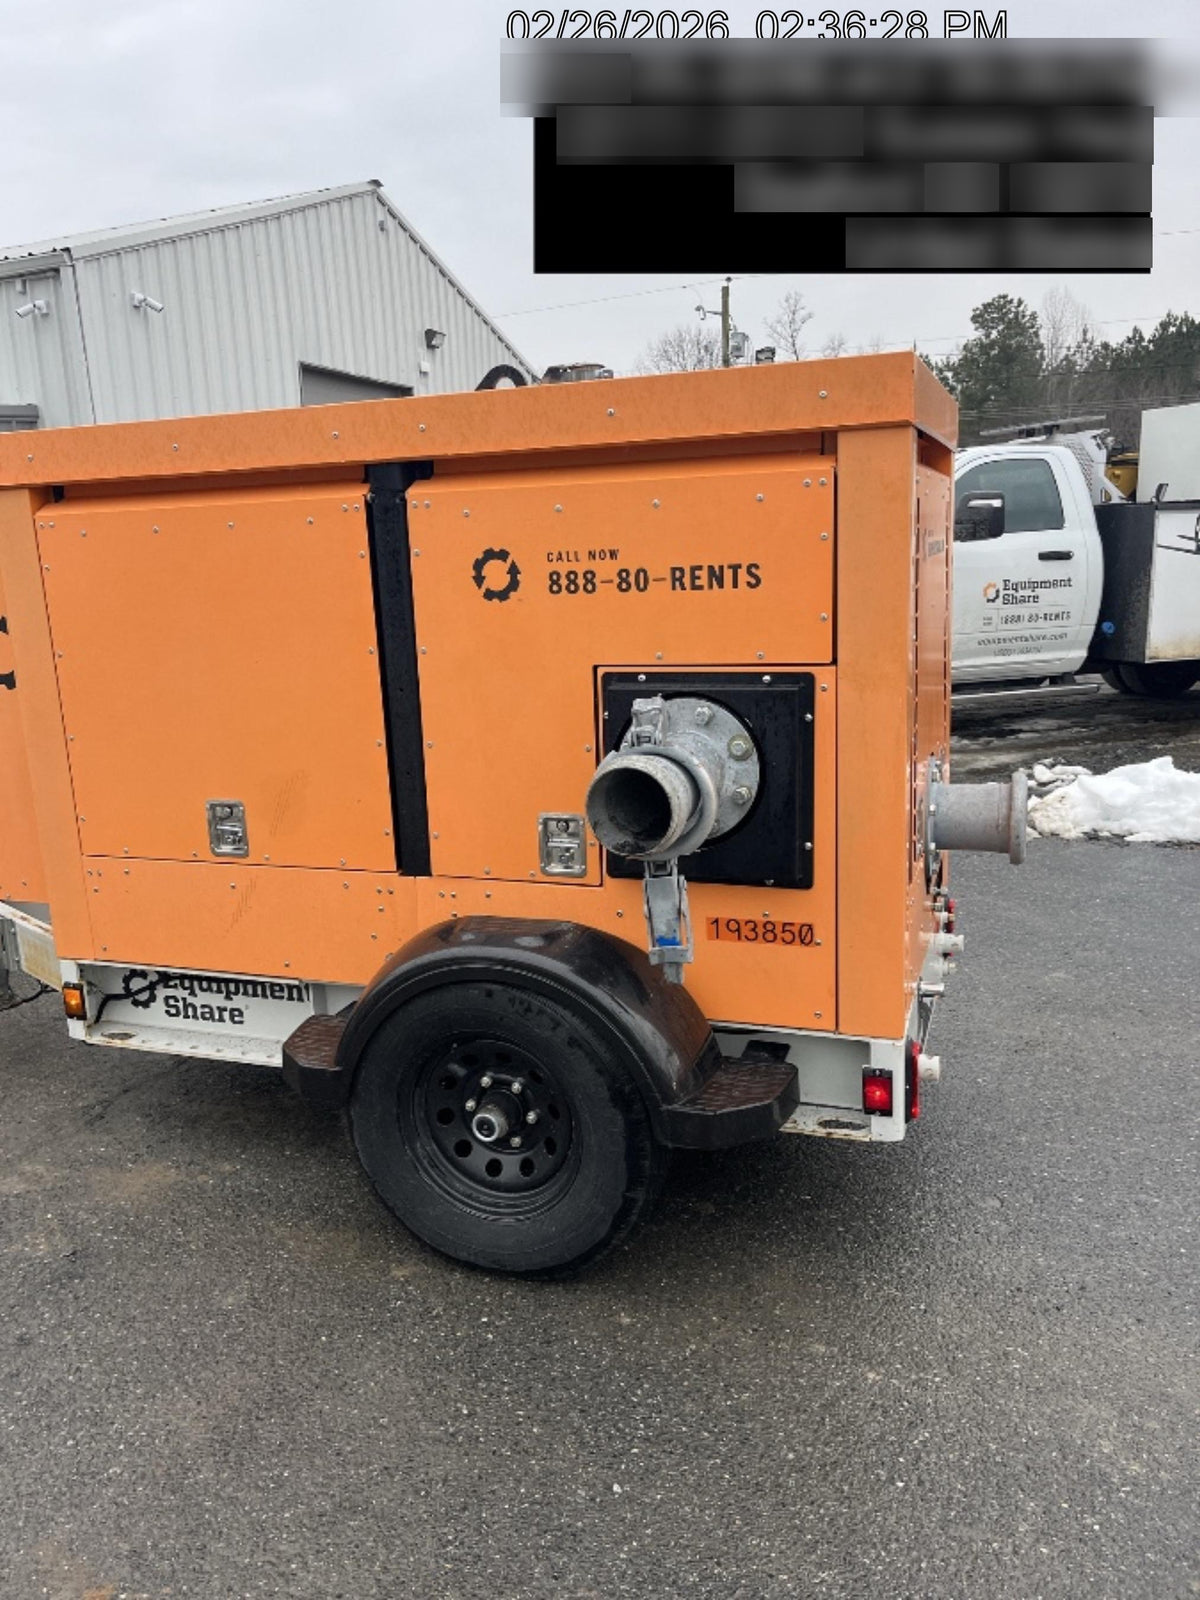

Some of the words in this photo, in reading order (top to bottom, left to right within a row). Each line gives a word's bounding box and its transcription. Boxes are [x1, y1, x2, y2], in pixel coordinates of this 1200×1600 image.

[547, 551, 580, 562] CALL
[588, 549, 619, 560] NOW
[548, 563, 762, 595] 888-80-RENTS
[1002, 577, 1073, 593] Equipment
[1002, 593, 1040, 605] Share
[710, 917, 814, 946] 193850
[163, 995, 245, 1025] Share
